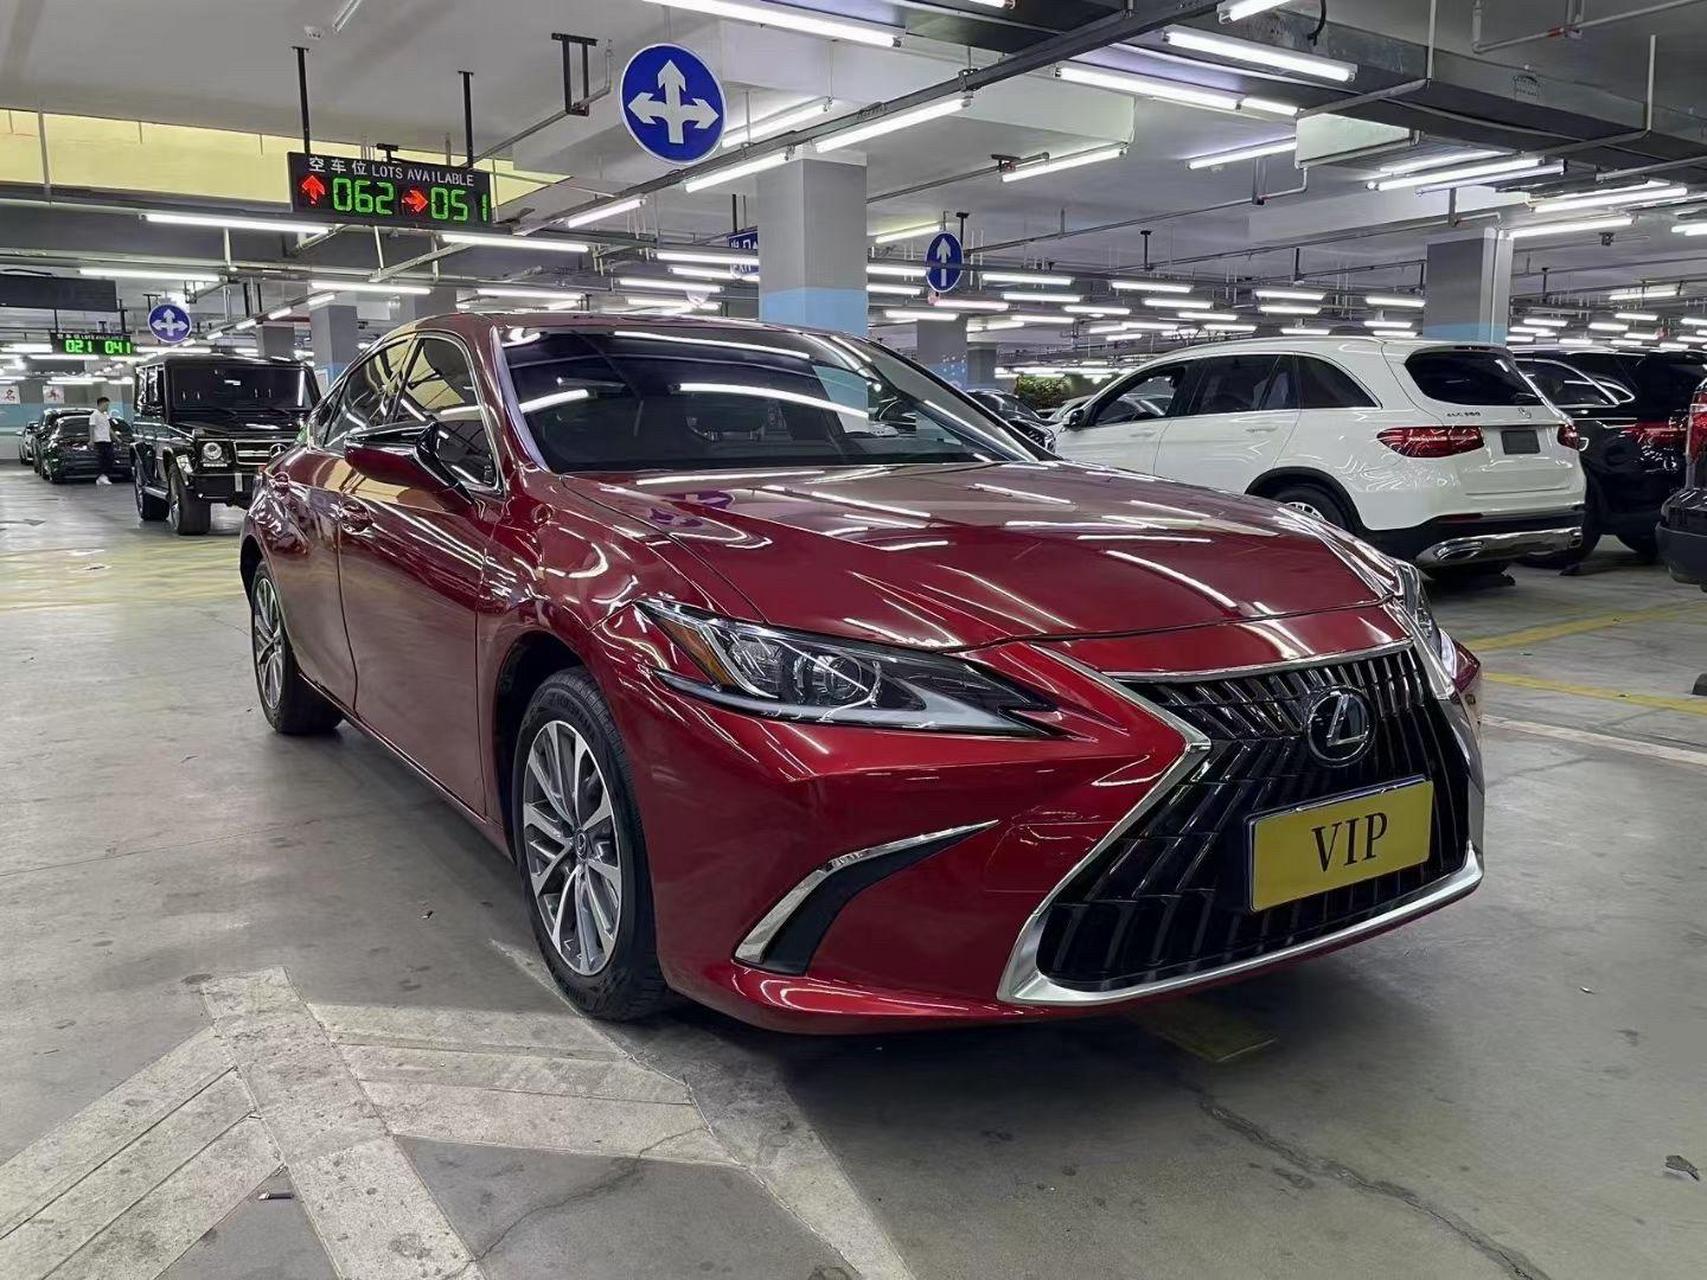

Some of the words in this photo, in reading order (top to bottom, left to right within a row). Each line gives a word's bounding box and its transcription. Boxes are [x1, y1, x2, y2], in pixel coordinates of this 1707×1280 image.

[309, 156, 367, 175] 空车位
[371, 166, 403, 180] LOTS
[407, 168, 475, 186] AVAILABLE
[332, 177, 395, 215] 062
[430, 186, 489, 222] 051
[65, 339, 93, 353] 021
[104, 340, 131, 354] 041
[1311, 811, 1388, 873] VIP
